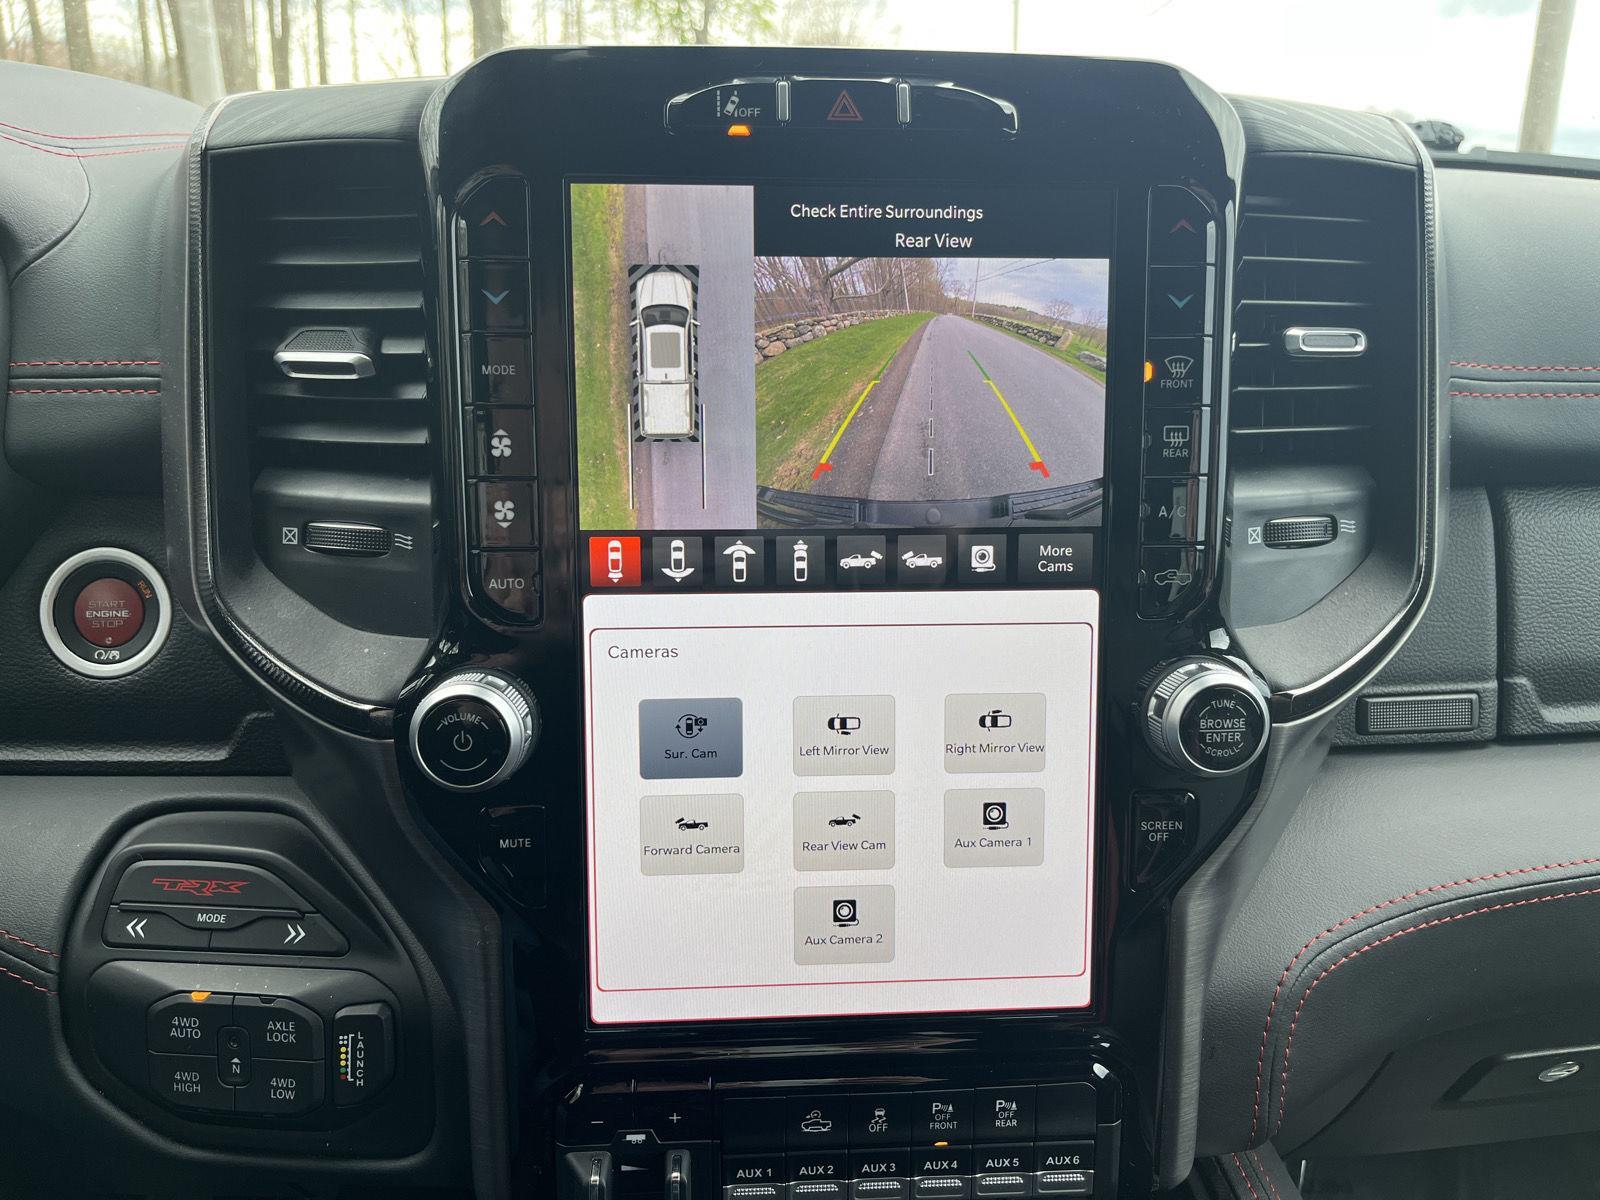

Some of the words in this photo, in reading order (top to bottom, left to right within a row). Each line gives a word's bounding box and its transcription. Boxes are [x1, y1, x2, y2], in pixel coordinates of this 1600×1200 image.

[738, 107, 761, 118] OFF
[790, 204, 836, 218] Check
[839, 204, 882, 218] Entire
[885, 204, 984, 221] Surroundings
[895, 233, 931, 248] Rear
[934, 233, 973, 248] View
[481, 365, 516, 375] MODE
[1160, 379, 1194, 389] FRONT
[1162, 449, 1189, 458] REAR
[1158, 506, 1186, 518] A/C
[1039, 545, 1073, 557] More
[1037, 561, 1074, 573] Cams
[488, 578, 525, 590] AUTO
[88, 600, 126, 609] START
[85, 610, 130, 618] ENGINE
[92, 620, 124, 628] STOP
[608, 646, 679, 660] Cameras
[1211, 699, 1237, 709] TUNE
[441, 711, 483, 726] VOLUME
[1200, 718, 1246, 730] BROWSE
[1206, 732, 1242, 743] ENTER
[664, 749, 688, 760] Sur.
[691, 748, 718, 760] Cam
[799, 745, 821, 757] Left
[823, 745, 859, 756] Mirror
[861, 744, 890, 755] View
[945, 743, 976, 756] Right
[978, 742, 1016, 754] Mirror
[1017, 742, 1046, 753] View
[1204, 746, 1241, 758] SCROLL
[1140, 820, 1183, 831] SCREEN
[954, 838, 977, 849] Aux
[979, 837, 1022, 848] Camera
[1027, 837, 1032, 847] 1
[1148, 832, 1169, 842] OFF
[499, 838, 532, 849] MUTE
[802, 841, 829, 852] Rear
[831, 840, 860, 851] View
[861, 840, 887, 851] Cam
[643, 845, 693, 857] Forward
[695, 844, 741, 855] Camera
[151, 876, 250, 897] TRX
[196, 913, 227, 924] MODE
[804, 935, 827, 946] Aux
[829, 933, 873, 945] Camera
[876, 933, 884, 944] 2
[171, 1016, 200, 1028] 4WD
[266, 1020, 296, 1032] AXLE
[169, 1027, 202, 1040] AUTO
[266, 1032, 297, 1043] LOCK
[355, 1031, 365, 1087] LAUNCH
[232, 1064, 241, 1075] N
[174, 1071, 200, 1082] 4WD
[270, 1077, 296, 1088] 4WD
[173, 1081, 201, 1093] HIGH
[270, 1088, 296, 1100] LOW
[932, 1102, 942, 1114] P
[995, 1099, 1005, 1112] P
[934, 1113, 951, 1121] OFF
[998, 1111, 1015, 1120] OFF
[868, 1122, 889, 1133] OFF
[929, 1121, 958, 1130] FRONT
[995, 1119, 1018, 1128] REAR
[923, 1161, 950, 1170] AUX
[951, 1160, 958, 1169] 4
[985, 1158, 1012, 1168] AUX
[1013, 1157, 1019, 1167] 5
[1045, 1156, 1072, 1166] AUX
[1073, 1155, 1080, 1165] 6
[736, 1168, 764, 1179] AUX
[767, 1167, 772, 1177] 1
[799, 1166, 826, 1176] AUX
[827, 1165, 834, 1174] 2
[861, 1163, 888, 1174] AUX
[890, 1162, 896, 1172] 3
